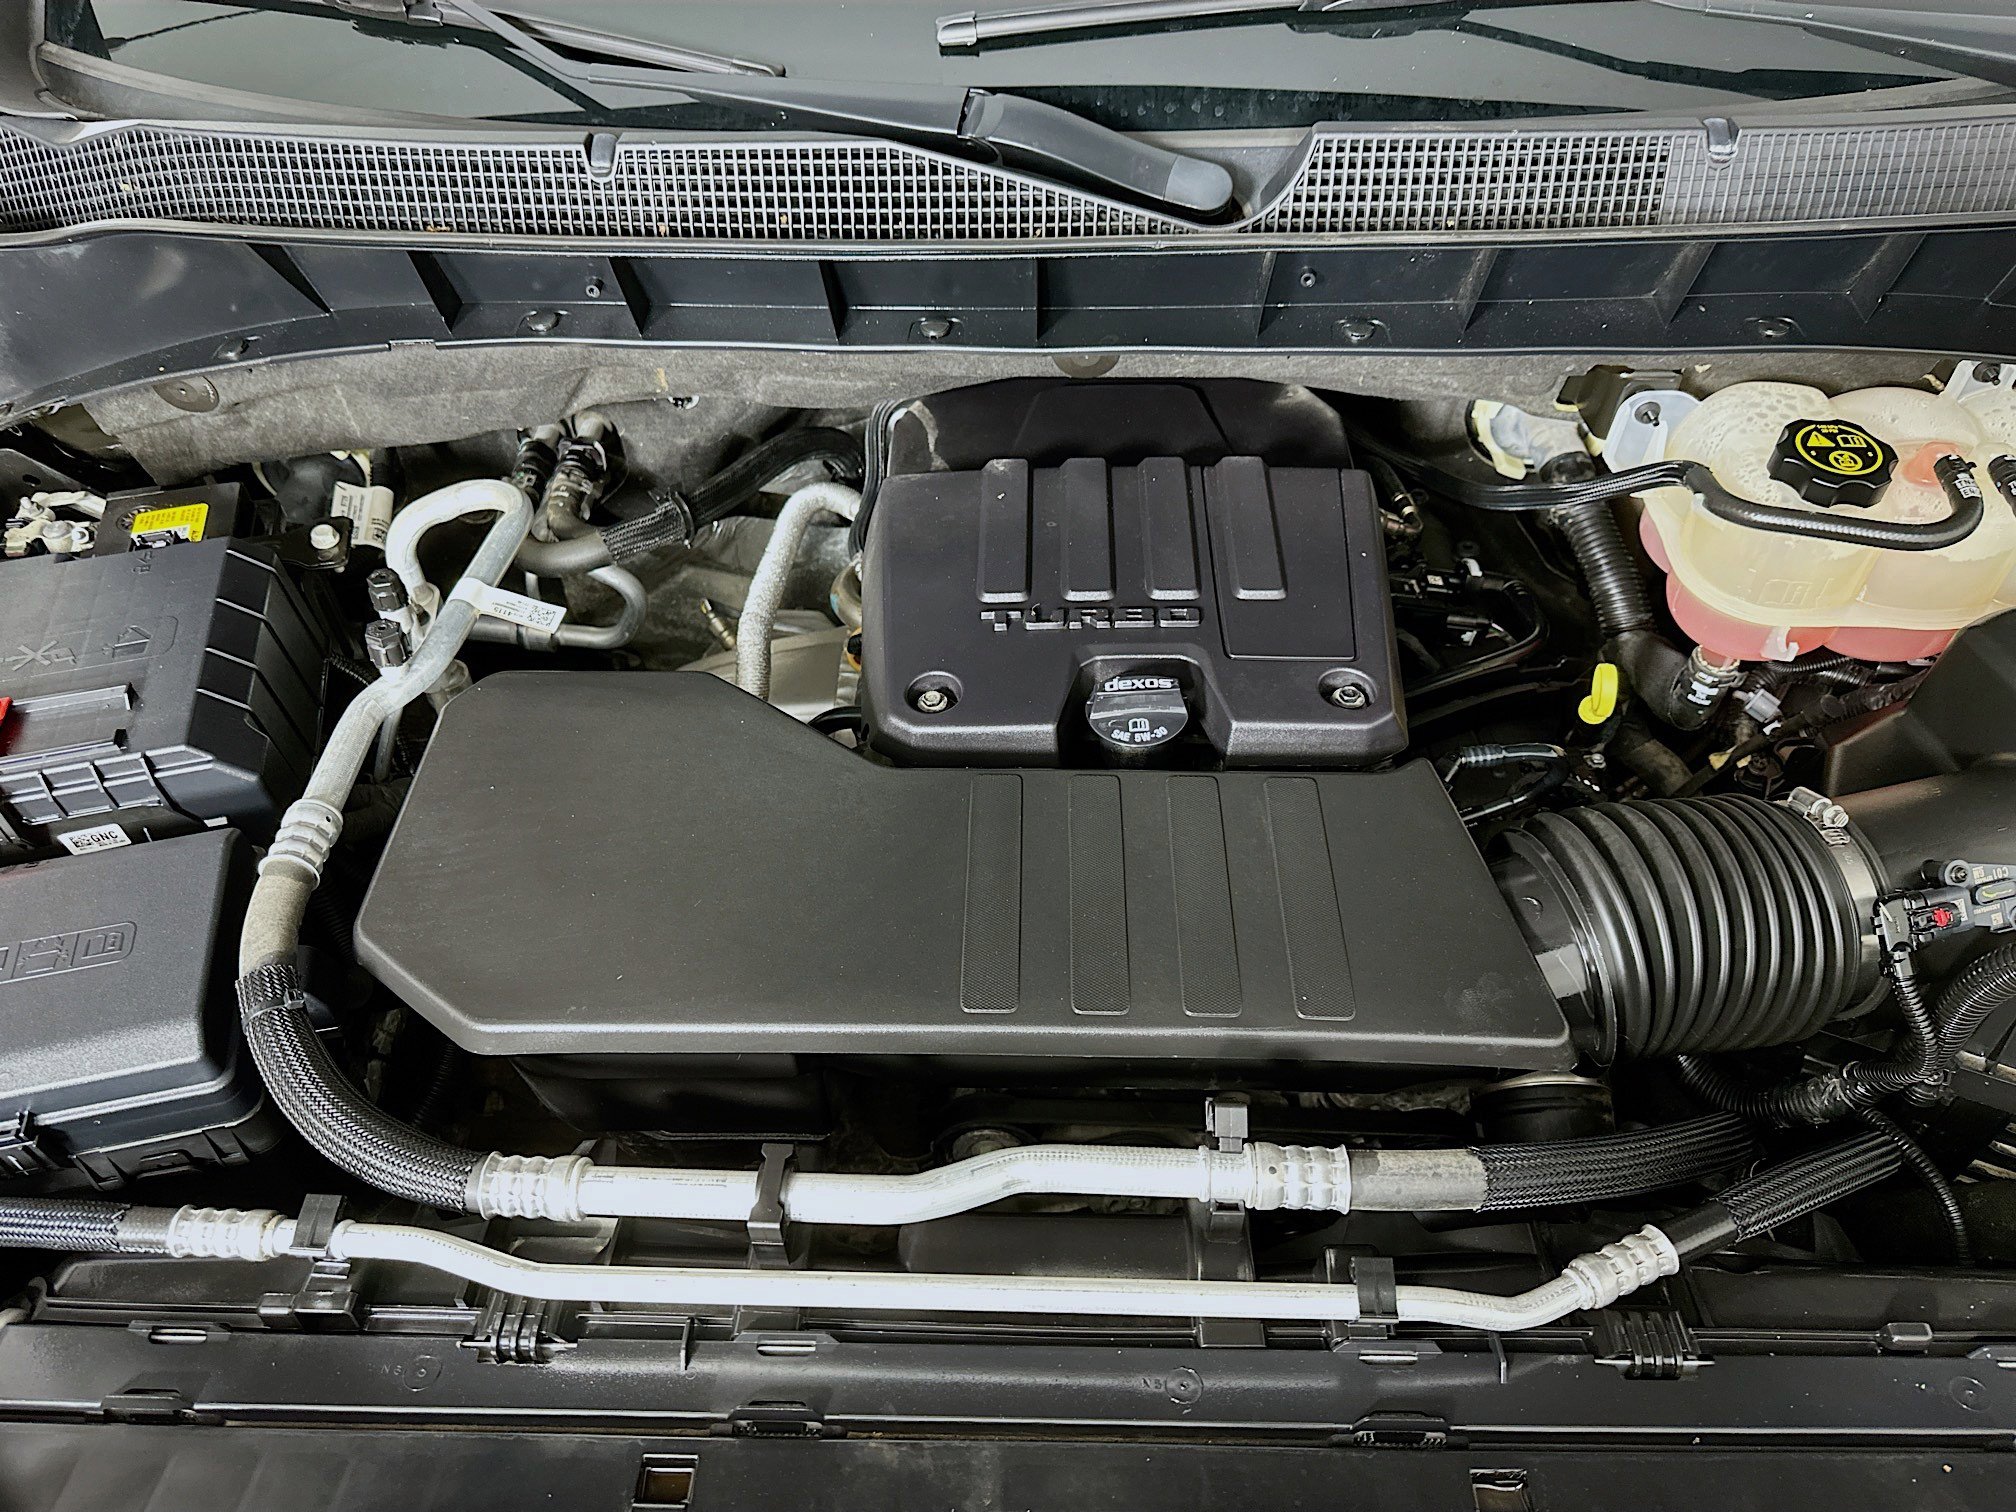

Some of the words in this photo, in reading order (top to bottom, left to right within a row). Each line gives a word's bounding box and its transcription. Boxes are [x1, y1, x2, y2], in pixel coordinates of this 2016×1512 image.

[979, 606, 1201, 632] TURBO
[1104, 675, 1174, 692] dexos
[1110, 728, 1132, 742] SAE
[1134, 725, 1169, 743] 5W-30
[89, 830, 119, 844] GNC
